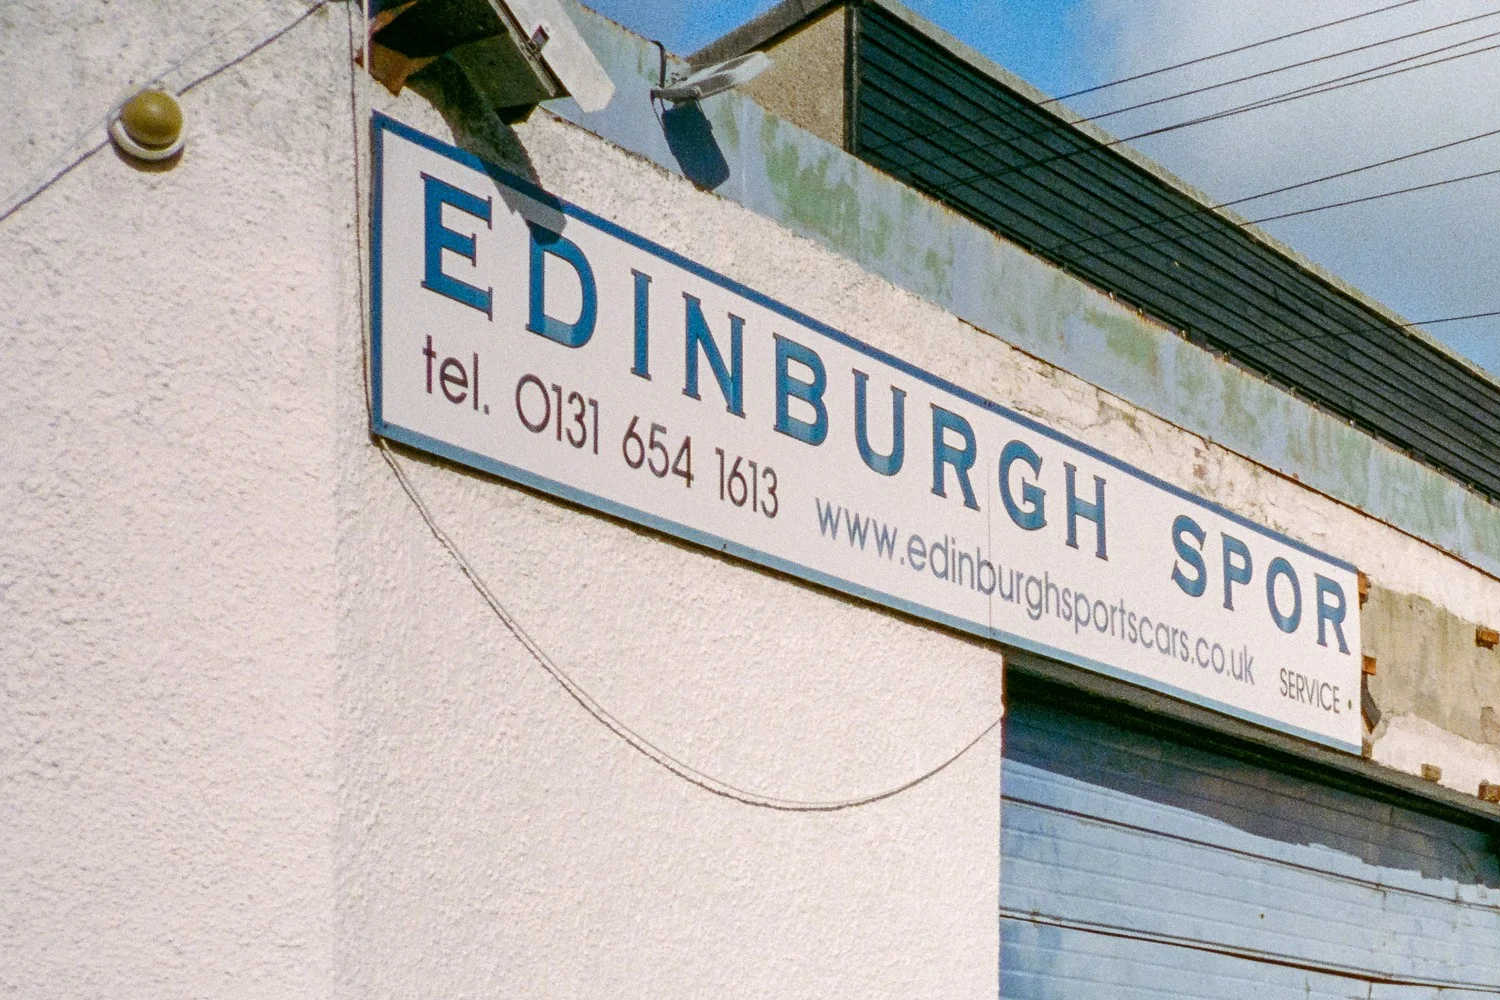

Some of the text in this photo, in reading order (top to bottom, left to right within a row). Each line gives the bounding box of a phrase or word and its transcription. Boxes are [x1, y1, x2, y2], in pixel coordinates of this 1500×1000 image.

[420, 172, 1351, 655] EDINBURGH SPOR
[422, 334, 1255, 686] tel. 0131 654 1613 www.edinburghsportscars.co.uk
[1279, 667, 1340, 714] SERVICE
